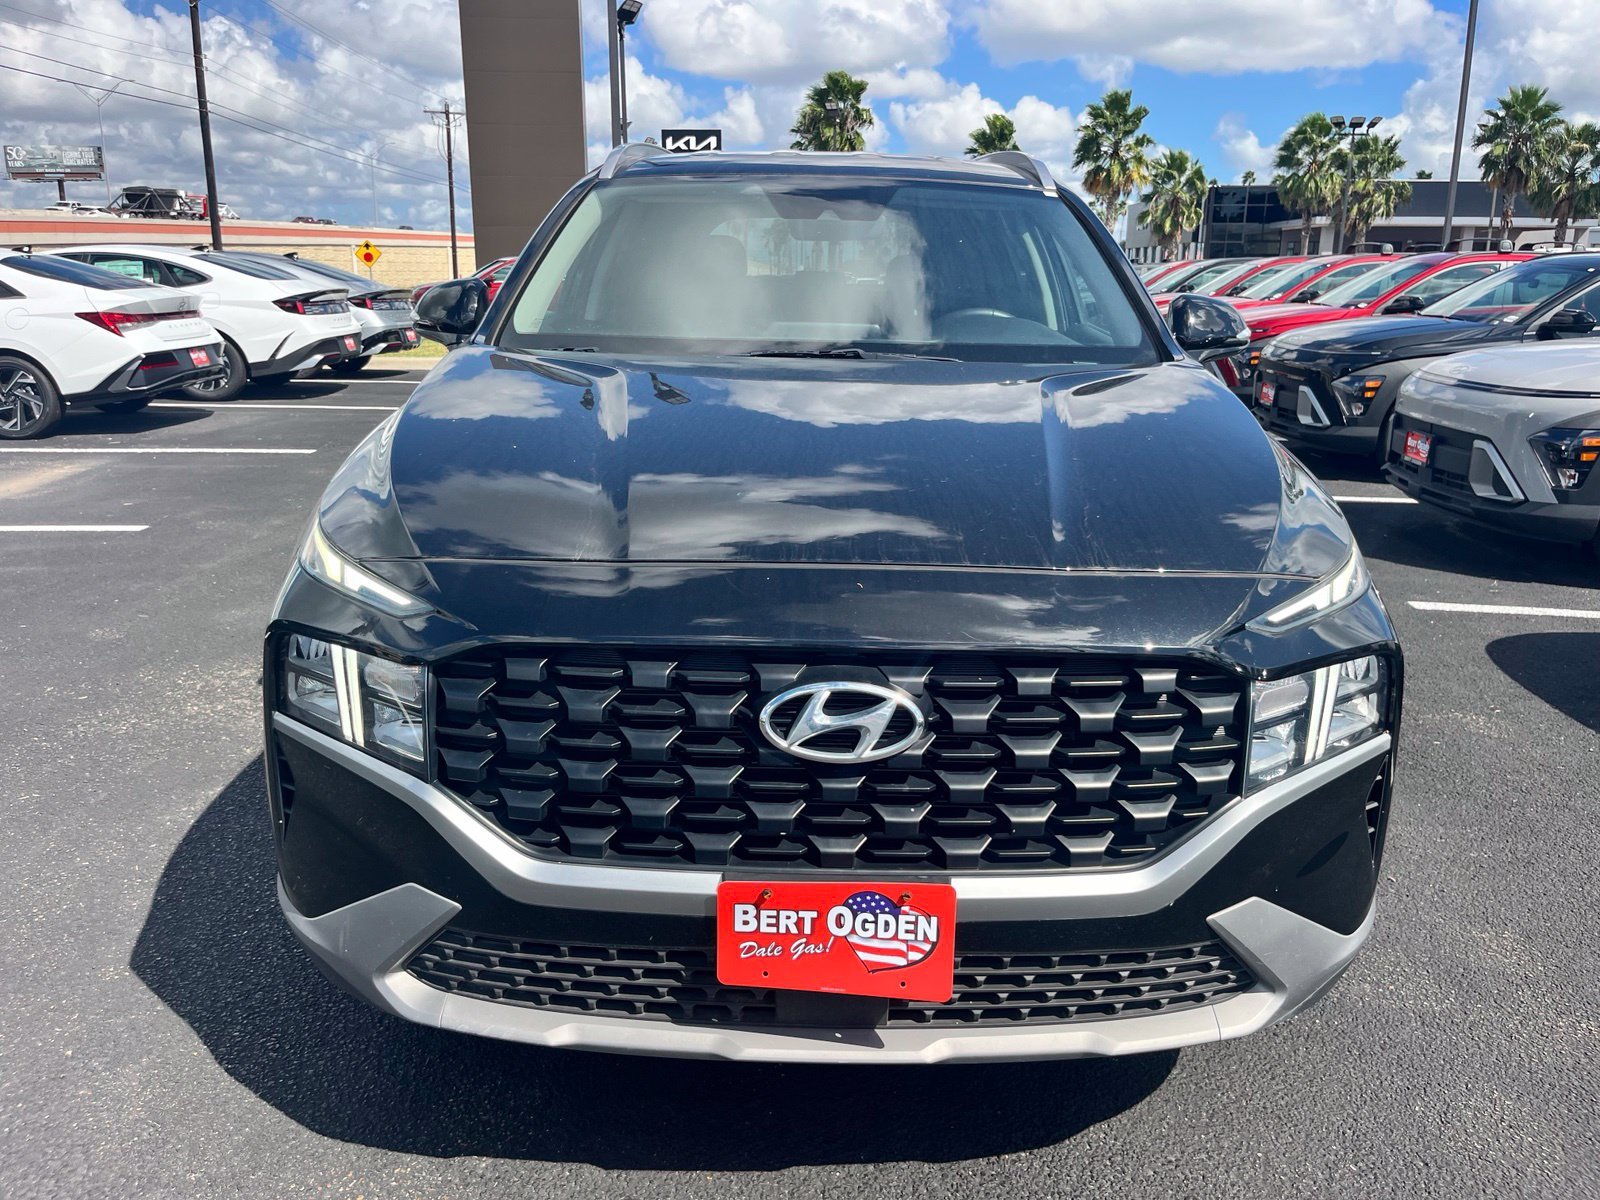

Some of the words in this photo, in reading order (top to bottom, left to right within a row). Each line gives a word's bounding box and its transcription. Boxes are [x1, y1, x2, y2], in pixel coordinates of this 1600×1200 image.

[666, 136, 717, 150] KIA
[734, 903, 817, 935] BERT
[827, 905, 938, 942] OGDEN
[739, 941, 783, 959] Dale
[790, 937, 834, 960] Gas!
